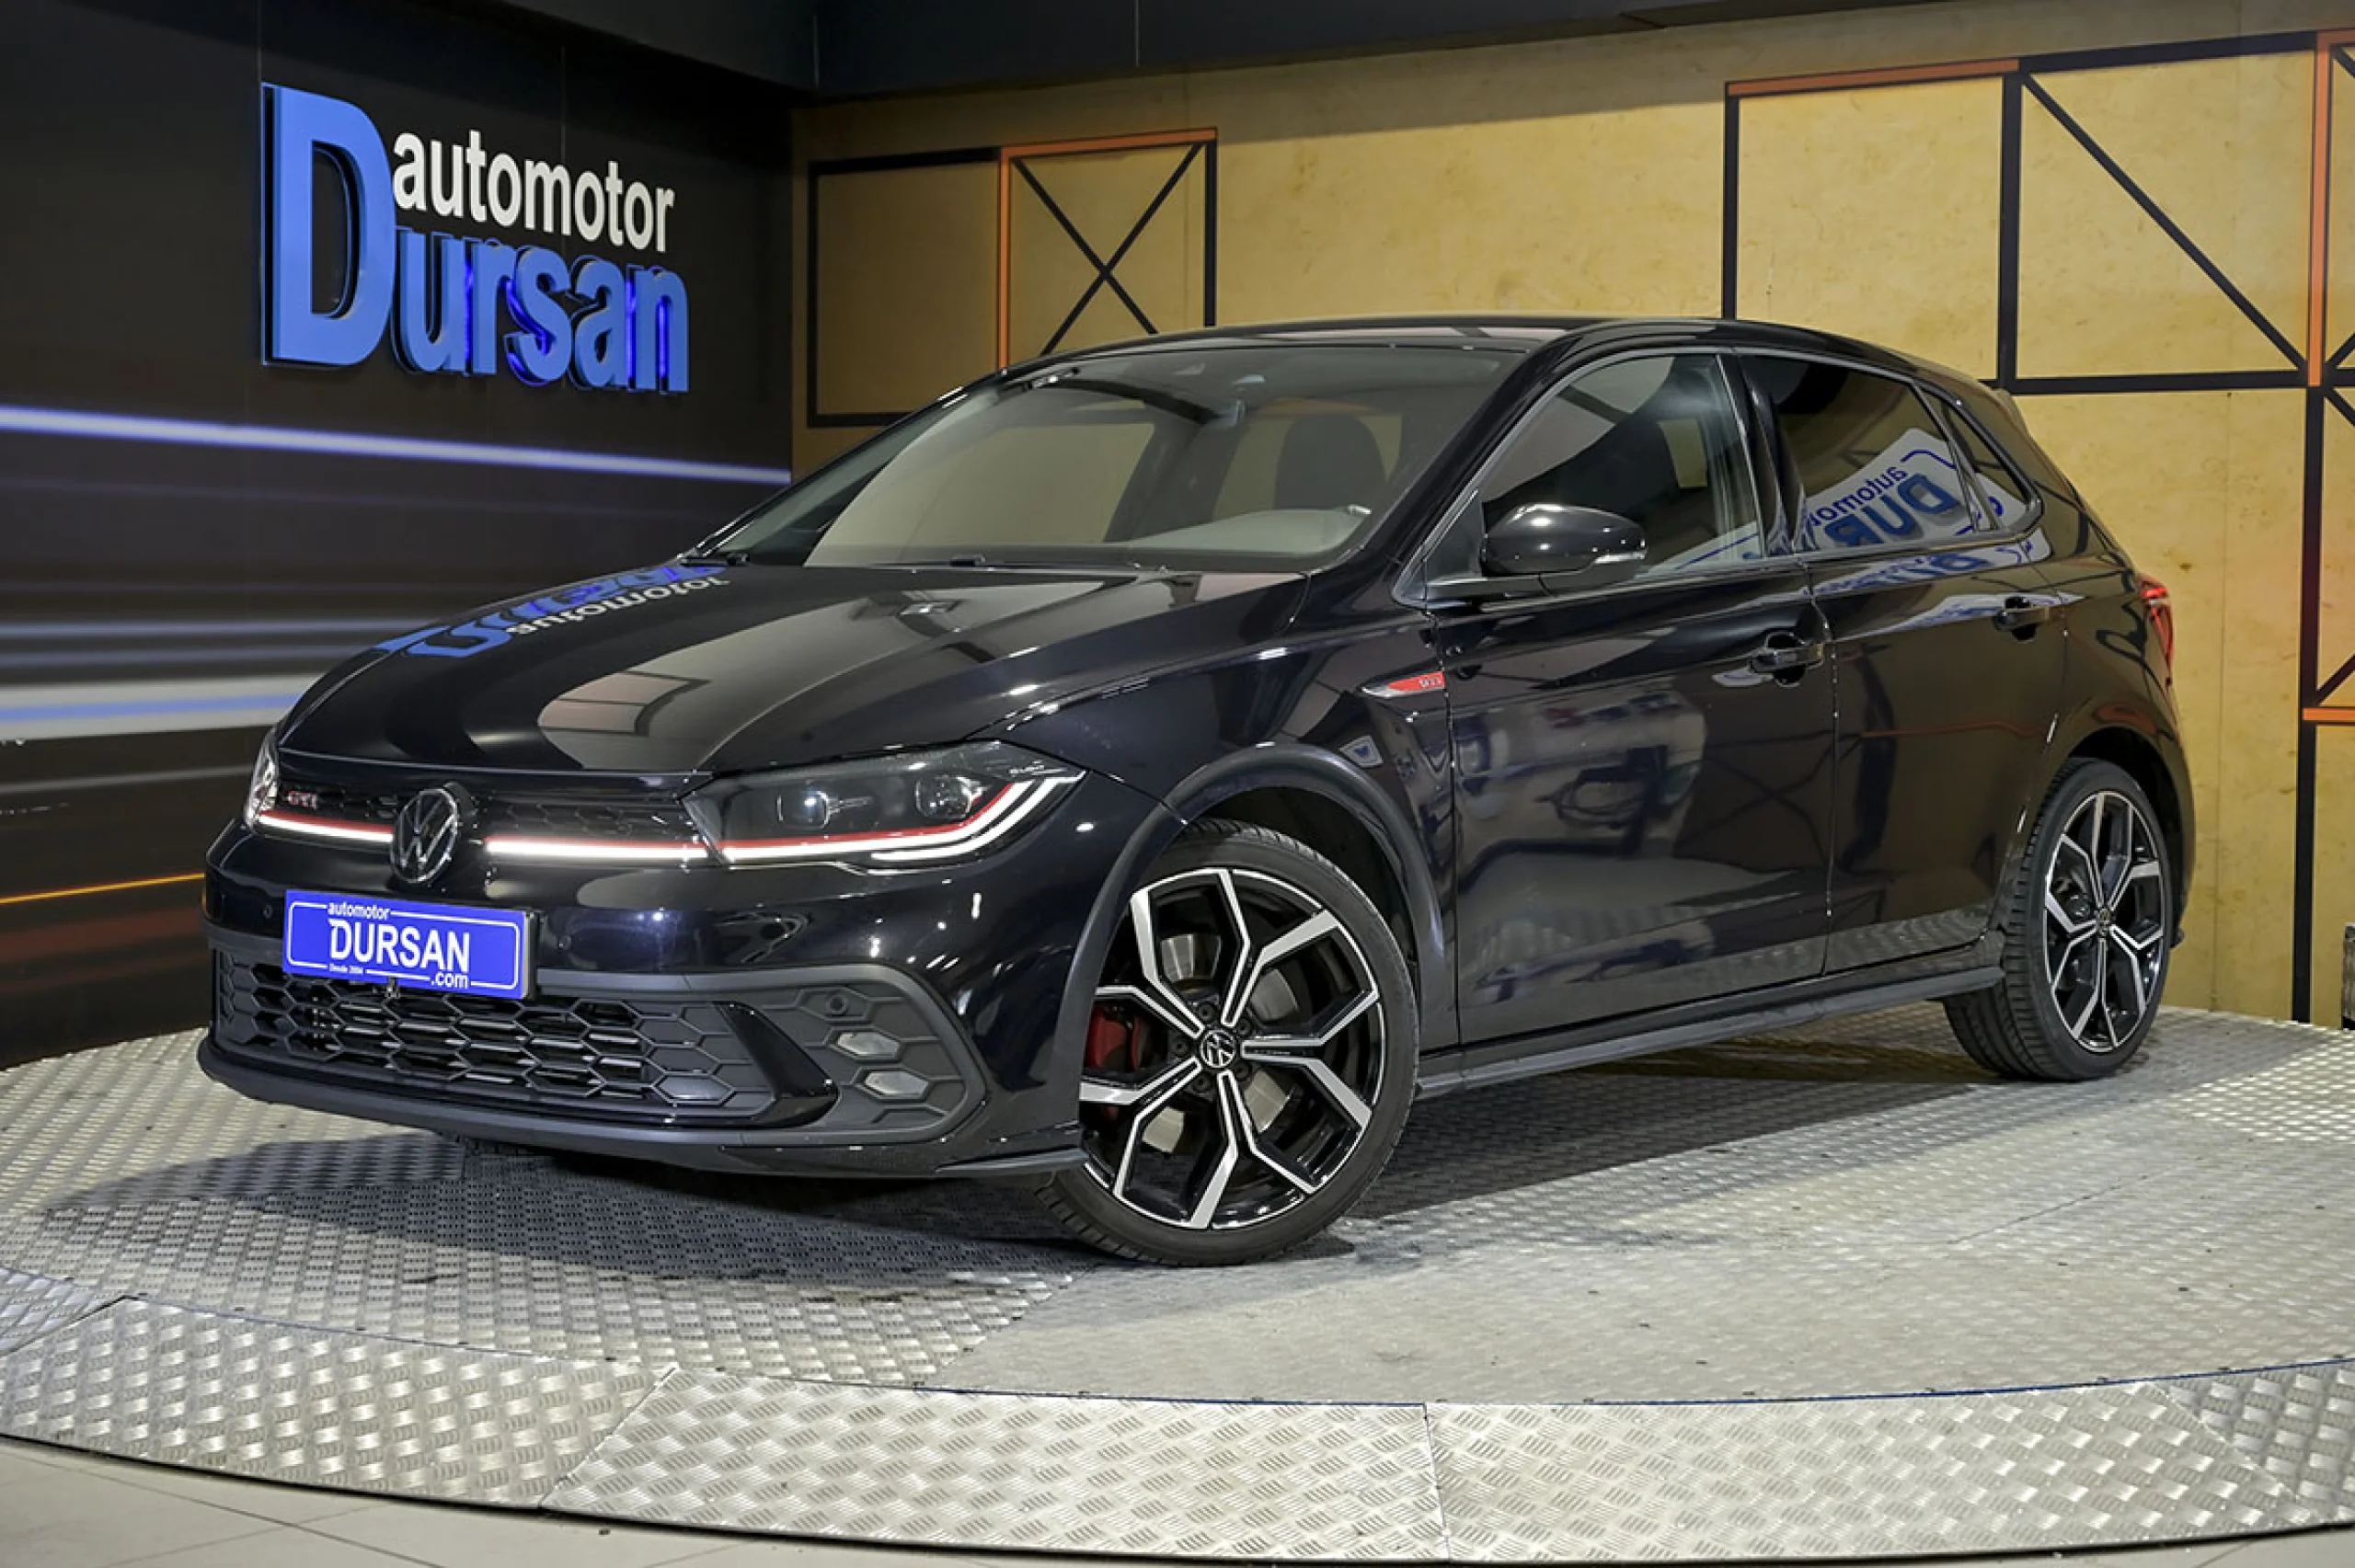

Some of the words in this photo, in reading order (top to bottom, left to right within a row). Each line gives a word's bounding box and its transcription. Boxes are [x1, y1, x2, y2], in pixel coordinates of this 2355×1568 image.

[393, 129, 674, 252] automotor
[261, 82, 689, 394] Dursan
[327, 901, 390, 921] automotor
[328, 919, 470, 973] DURSAN
[431, 970, 468, 990] .com
